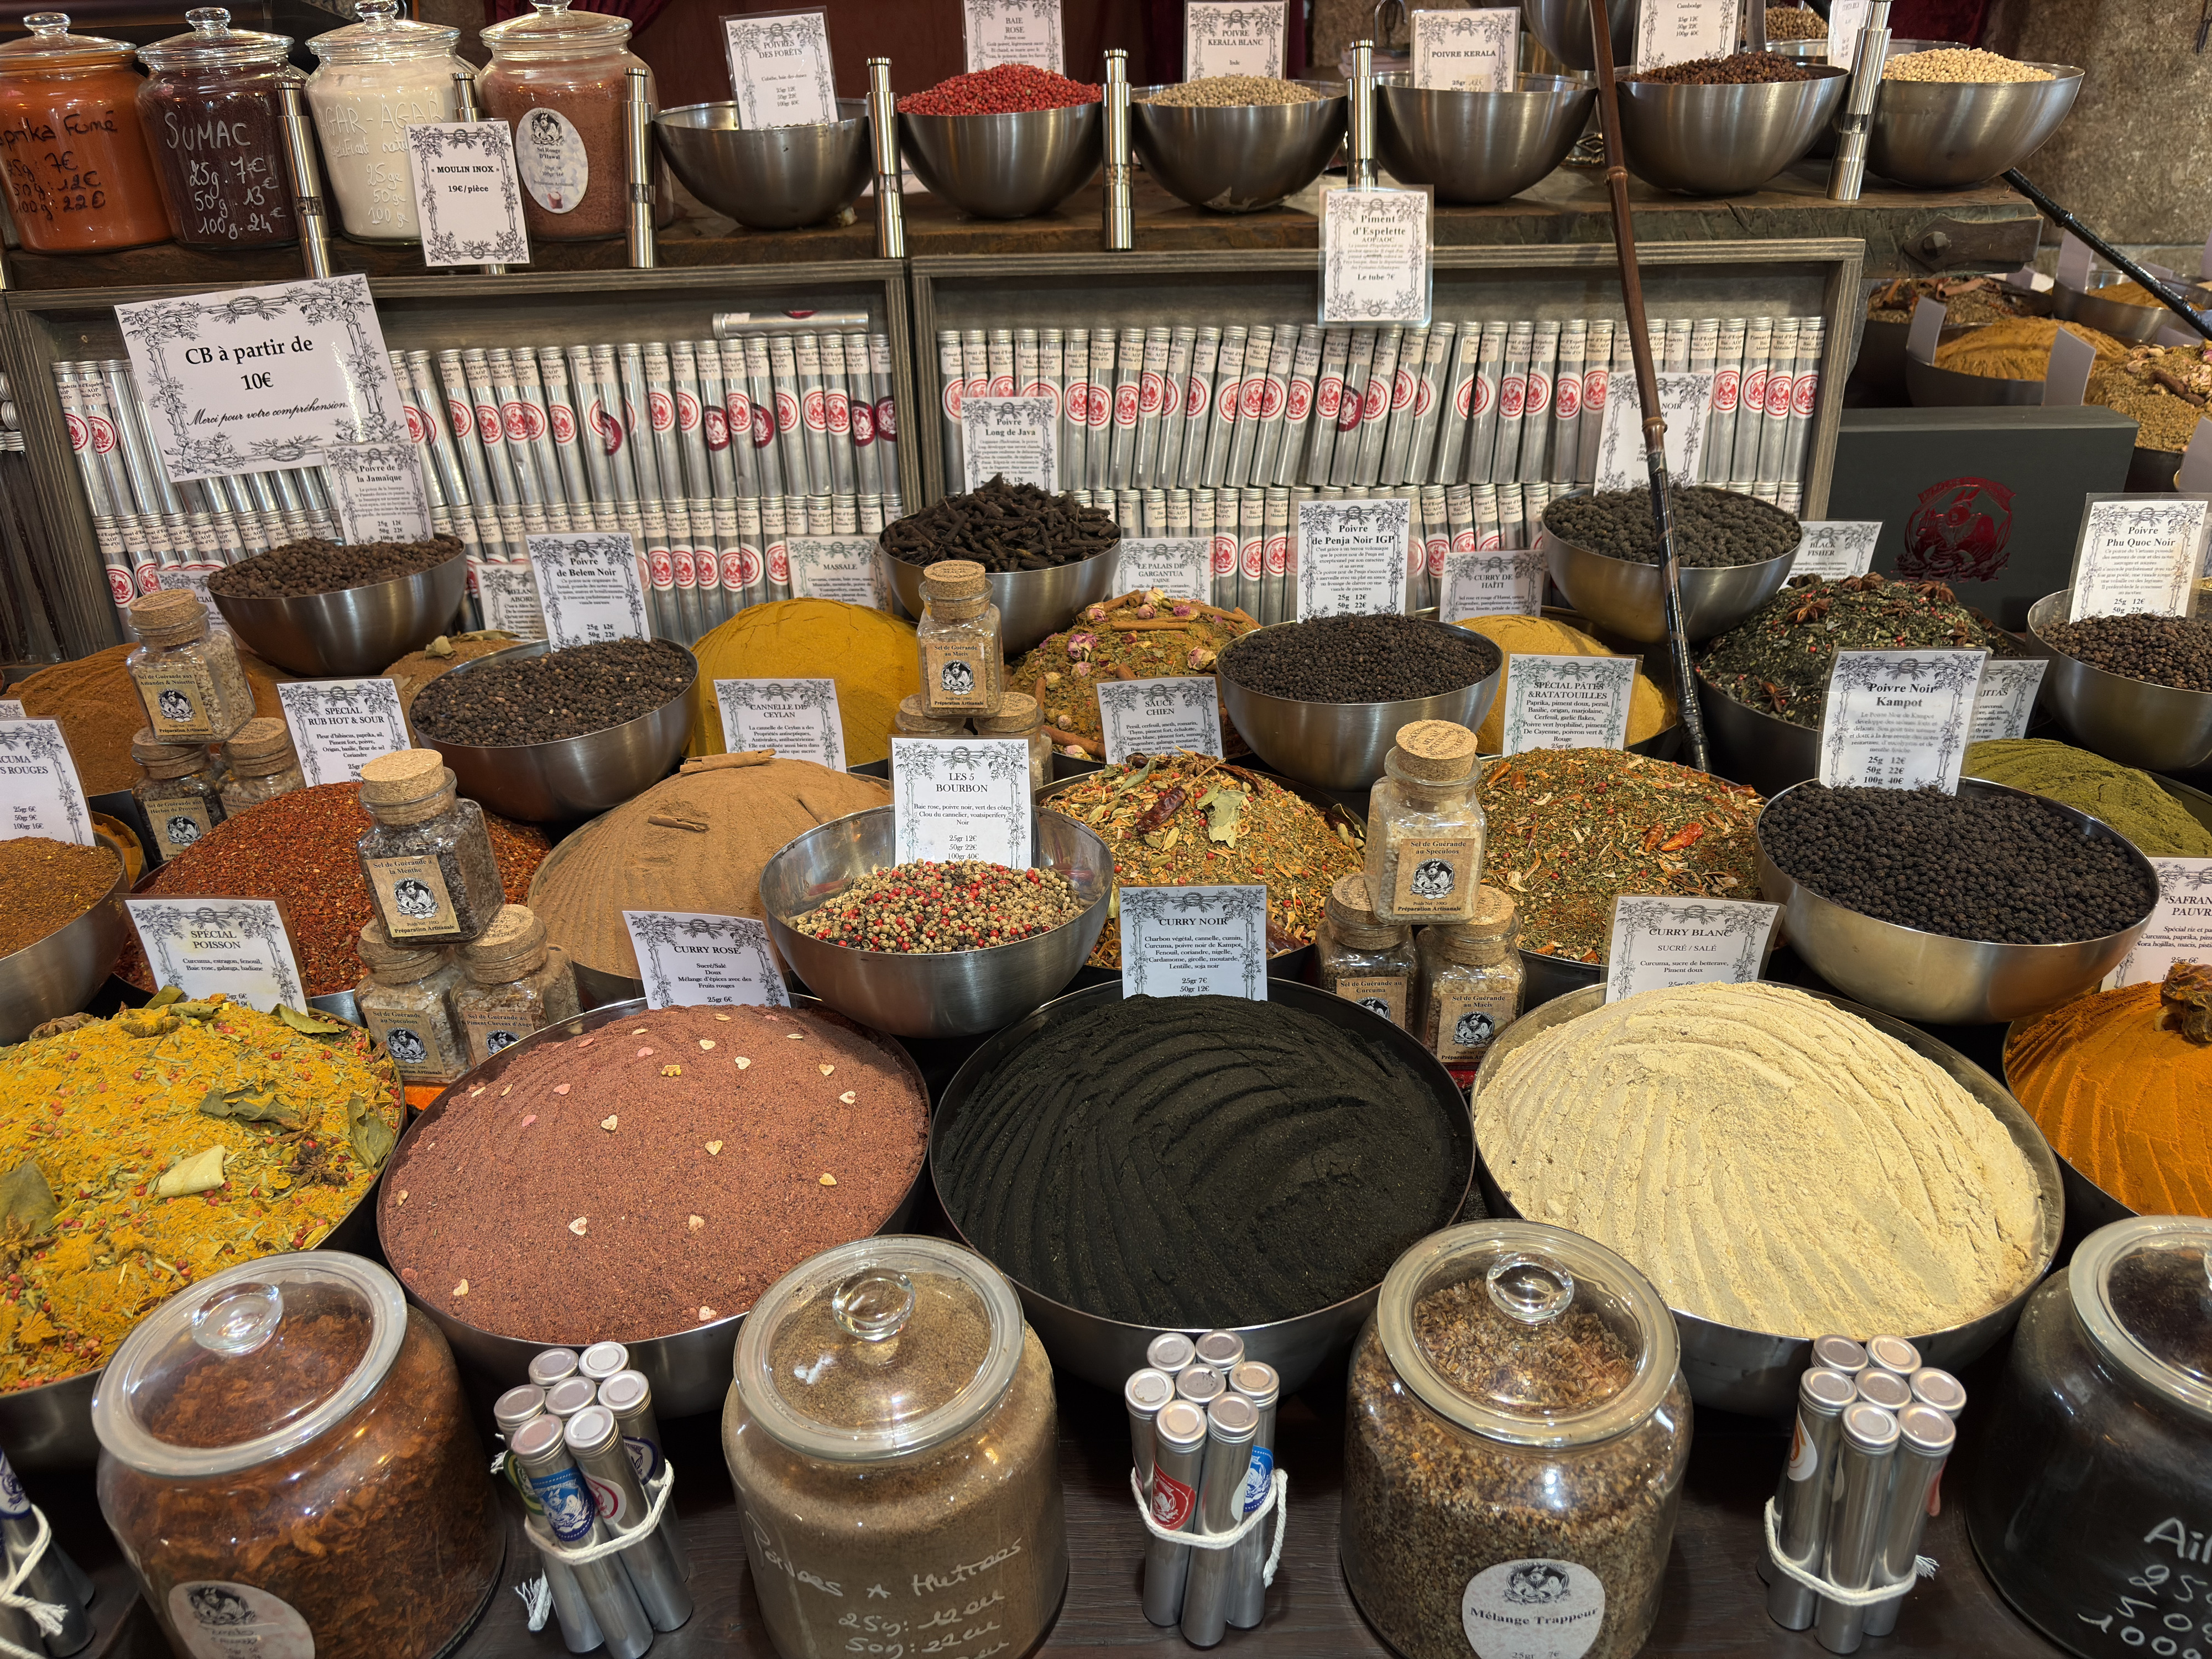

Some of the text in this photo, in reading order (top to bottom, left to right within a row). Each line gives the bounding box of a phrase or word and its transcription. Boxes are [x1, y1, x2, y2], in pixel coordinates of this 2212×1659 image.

[165, 112, 251, 150] SUMAC
[448, 185, 489, 194] 19€/pièce
[1361, 215, 1395, 223] Piment
[1353, 227, 1406, 237] d'Espelette
[186, 336, 313, 364] CB à partir de
[241, 372, 274, 390] 10€
[187, 408, 219, 426] Merci
[218, 413, 243, 427] pour
[246, 409, 270, 419] votre
[1325, 537, 1350, 545] Penja
[2127, 538, 2151, 547] Quoc
[2154, 538, 2176, 546] Noir
[570, 557, 598, 566] Poivre
[1869, 684, 1937, 693] Poivre Noir
[1876, 697, 1923, 708] Kampot
[191, 930, 237, 938] SPÉCIAL
[1471, 1607, 1598, 1625] Mélange Trappeur
